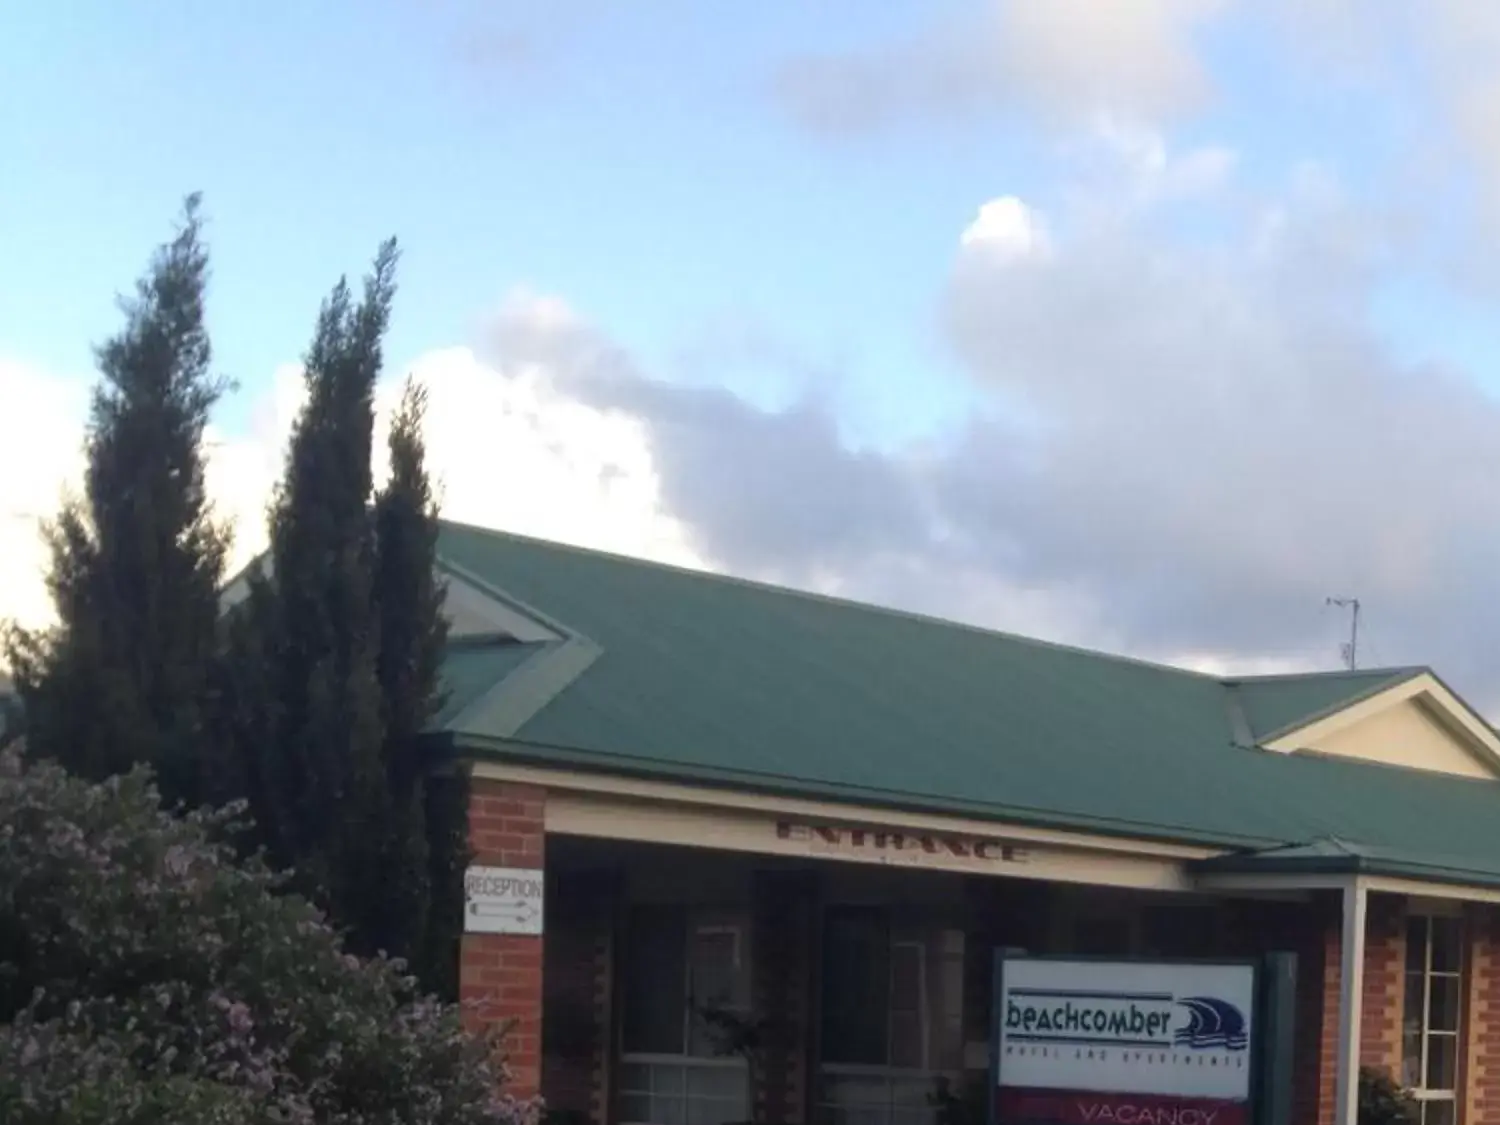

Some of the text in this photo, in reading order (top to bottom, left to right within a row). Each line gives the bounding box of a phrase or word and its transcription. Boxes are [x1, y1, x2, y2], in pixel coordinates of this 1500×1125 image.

[777, 820, 1029, 863] ENTRANCE
[466, 874, 541, 899] RECEPTION
[1006, 1000, 1172, 1036] beachcomber
